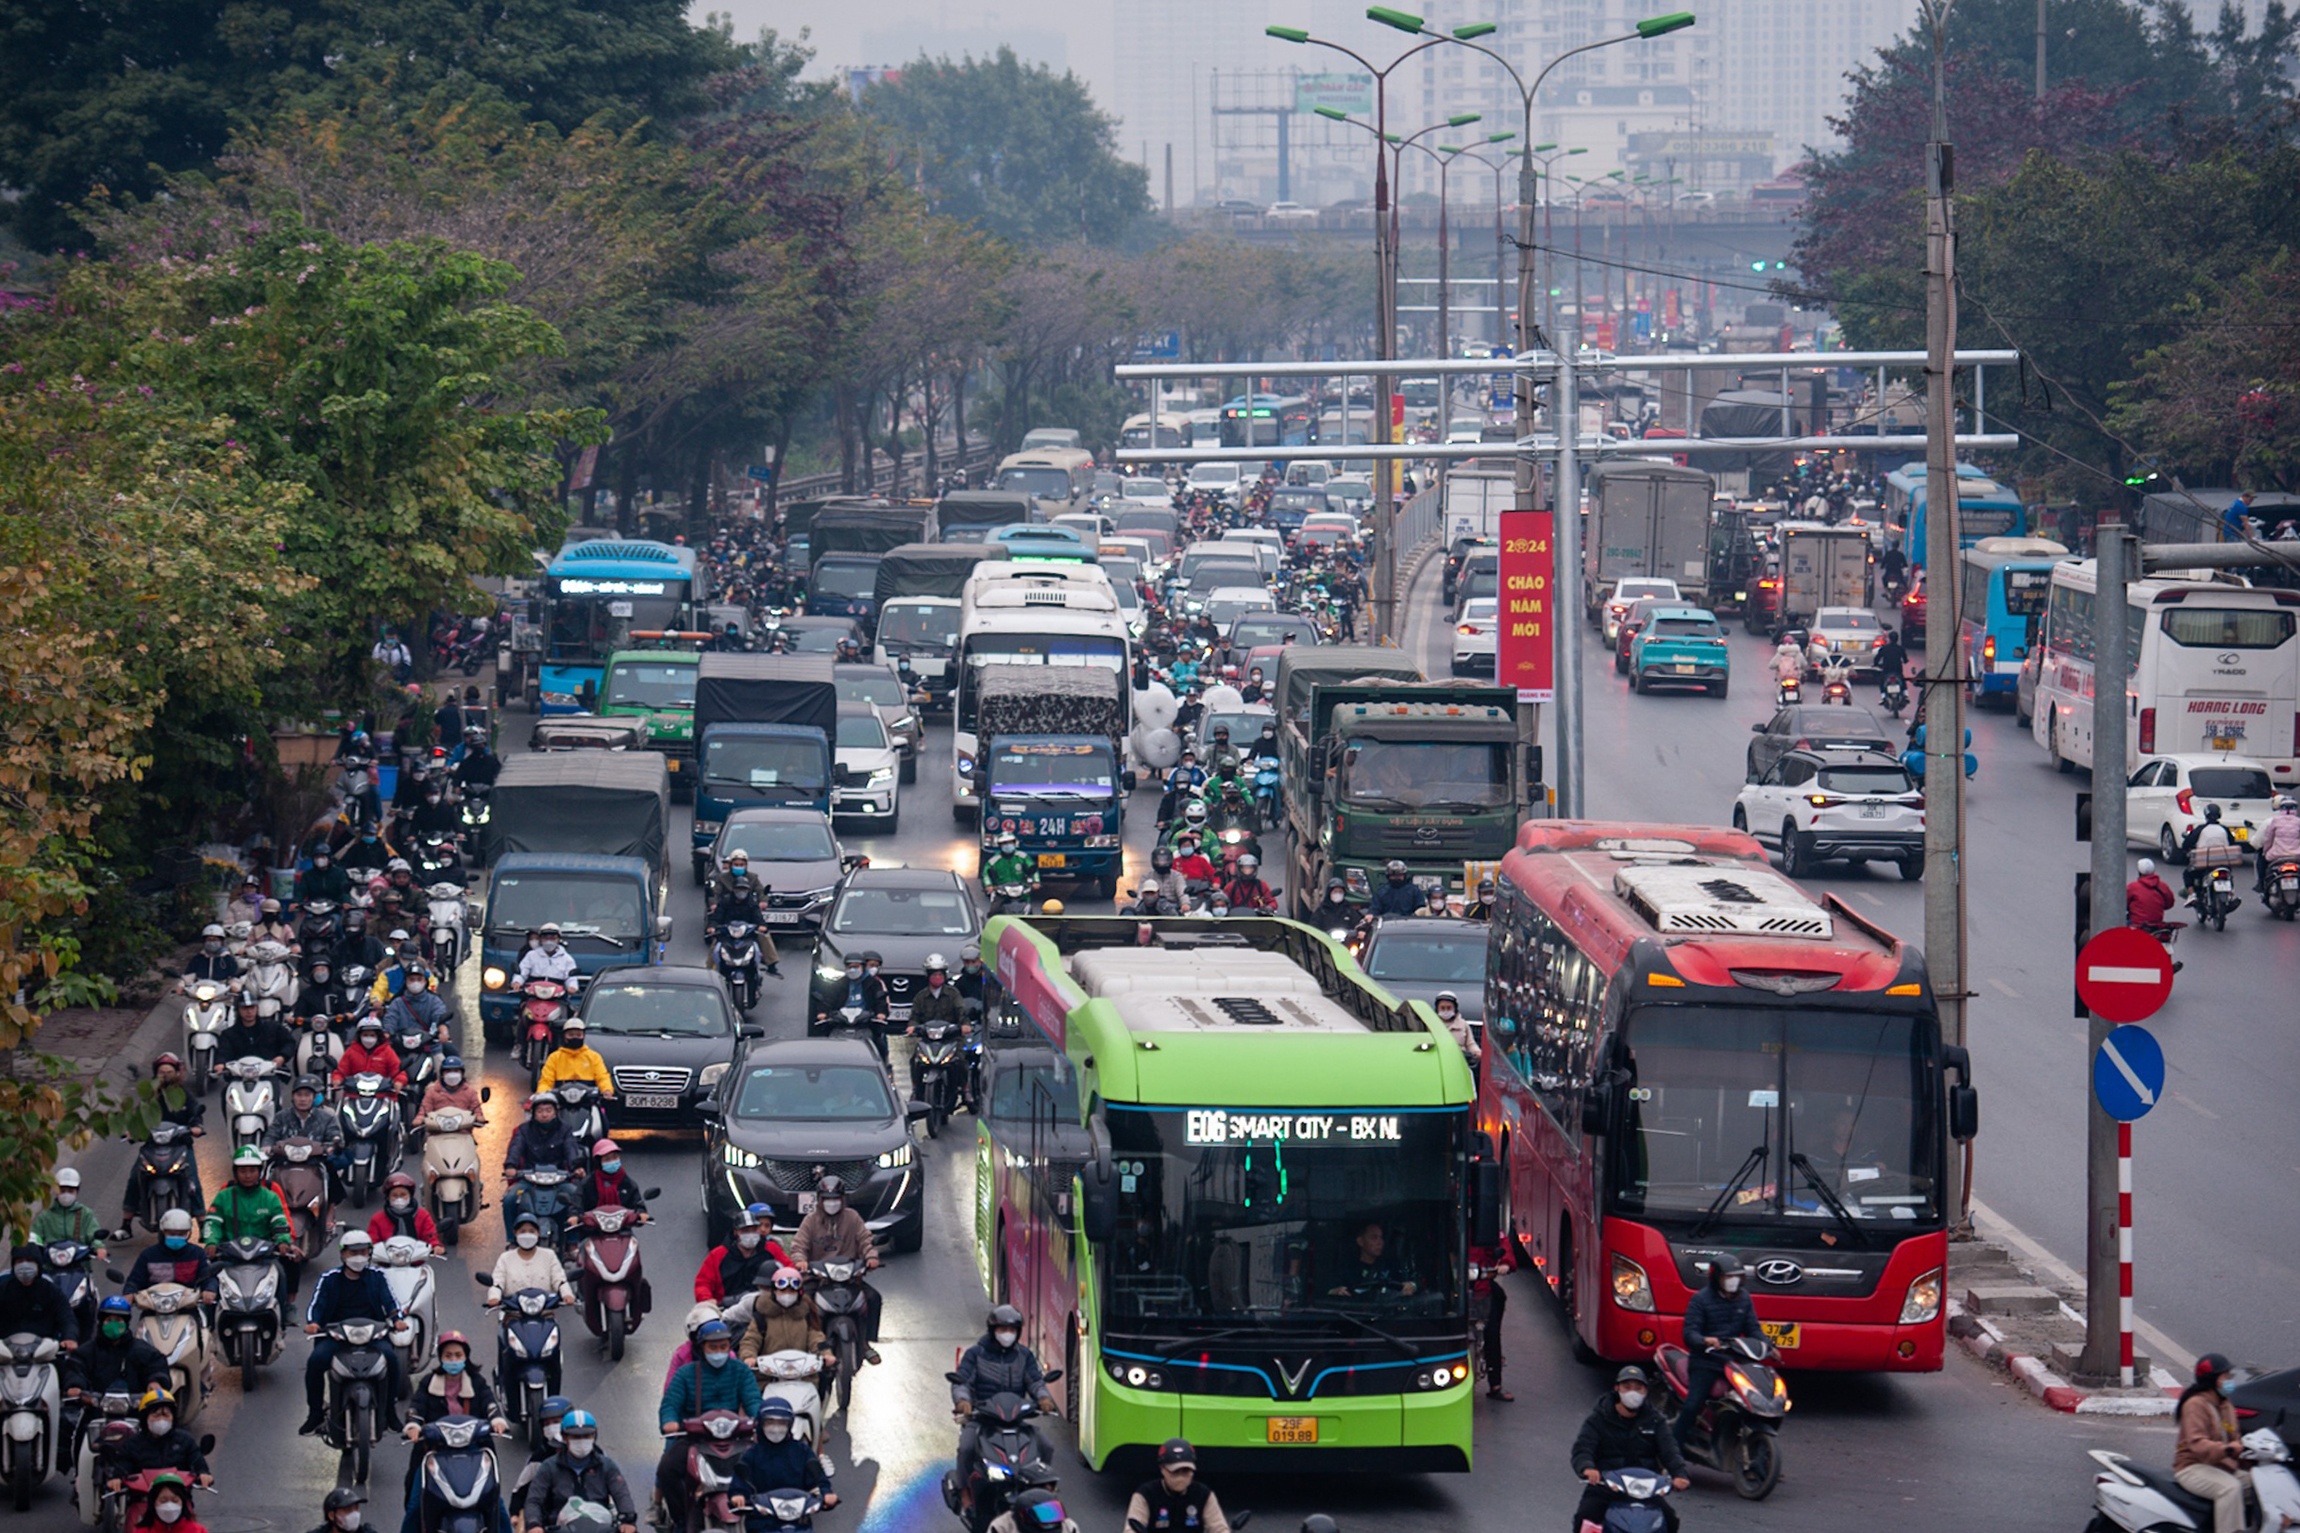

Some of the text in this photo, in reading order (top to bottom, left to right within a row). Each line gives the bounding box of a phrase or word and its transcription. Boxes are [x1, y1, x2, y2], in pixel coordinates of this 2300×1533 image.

[1505, 540, 1547, 553] 2024
[1507, 573, 1545, 589] CHÀO
[2232, 702, 2267, 714] LONG
[1039, 818, 1065, 836] 24H
[1336, 816, 1344, 832] 3
[1187, 1110, 1227, 1142] E06
[1229, 1116, 1293, 1141] SMART
[1295, 1117, 1333, 1141] CITY
[1350, 1117, 1377, 1141] BX
[1281, 1419, 1303, 1430] 29F
[1273, 1430, 1311, 1442] 019.88
